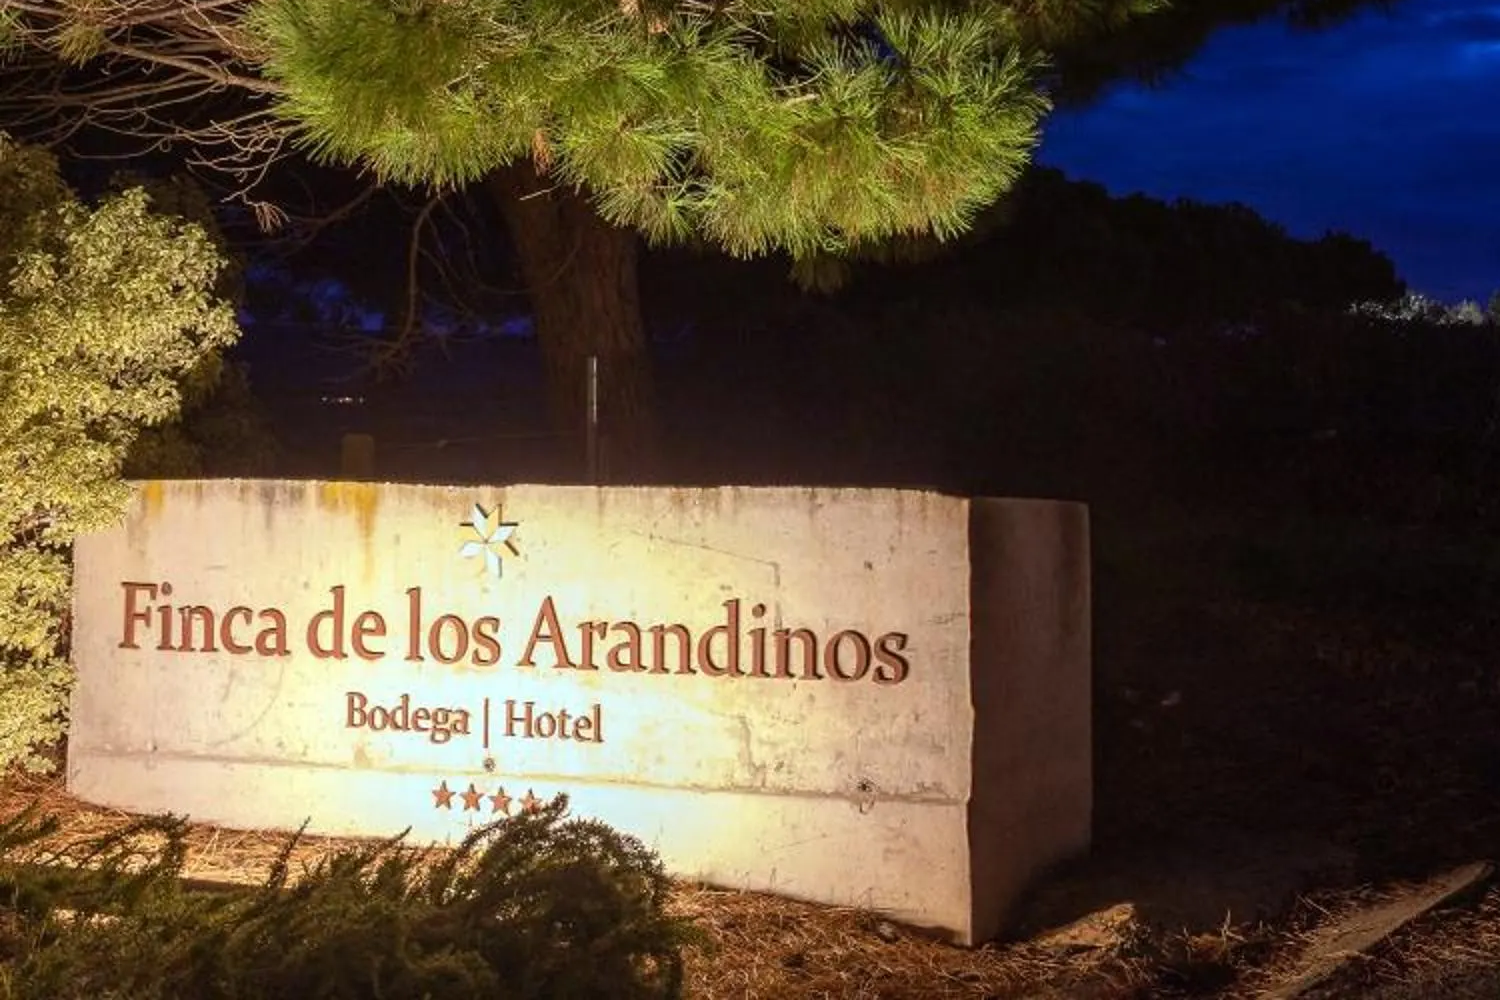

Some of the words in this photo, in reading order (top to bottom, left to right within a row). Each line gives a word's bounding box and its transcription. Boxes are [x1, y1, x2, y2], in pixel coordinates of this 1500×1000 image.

[118, 581, 291, 657] Finca
[306, 584, 387, 661] de
[404, 586, 502, 667] los
[516, 595, 911, 686] Arandinos
[345, 691, 471, 744] Bodega
[503, 699, 605, 743] Hotel
